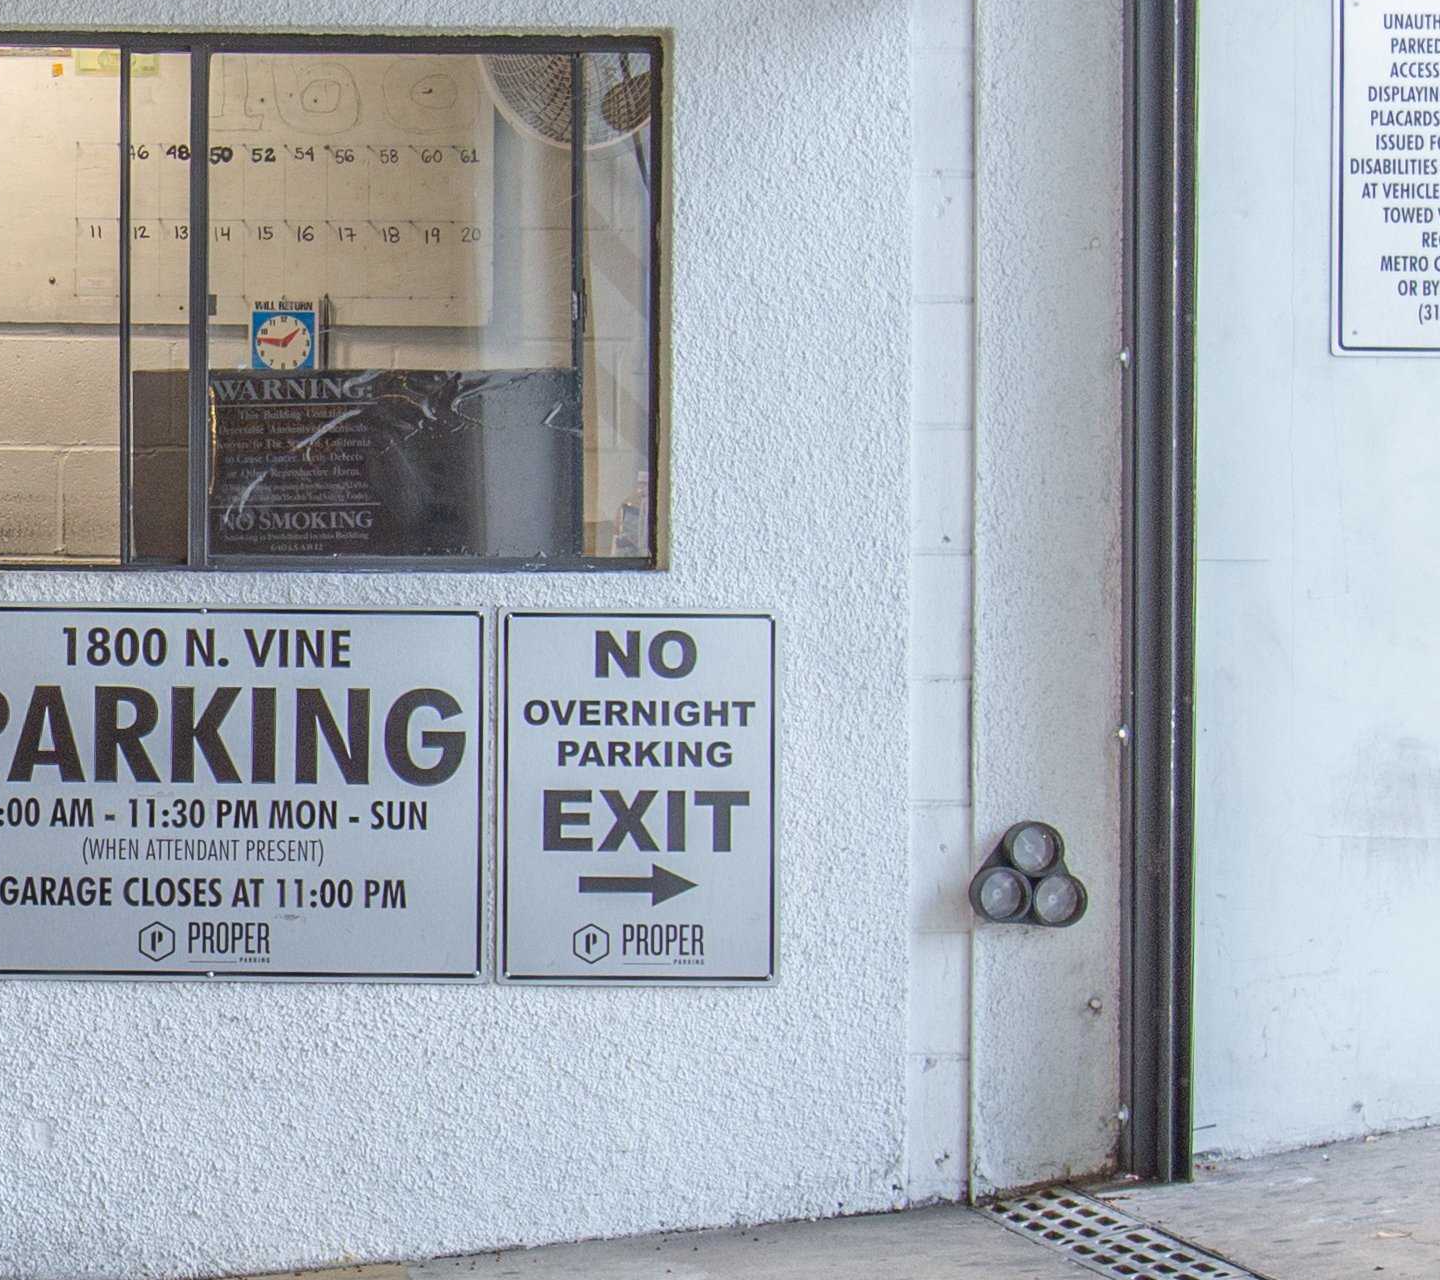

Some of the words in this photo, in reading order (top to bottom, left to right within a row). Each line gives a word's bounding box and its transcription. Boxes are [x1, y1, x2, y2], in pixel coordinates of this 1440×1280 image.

[1371, 110, 1440, 127] PLACARDS
[1376, 134, 1424, 151] ISSUED
[166, 144, 191, 161] 48
[209, 146, 233, 164] 50
[251, 148, 276, 163] 52
[294, 147, 315, 163] 54
[335, 149, 355, 164] 56
[379, 149, 399, 163] 58
[421, 149, 443, 164] 60
[460, 149, 480, 163] 61
[1350, 158, 1438, 175] DISABILITIES
[1362, 183, 1378, 199] AT
[1383, 207, 1434, 224] TOWED
[90, 225, 102, 239] 11
[133, 225, 150, 239] 12
[174, 226, 189, 240] 13
[214, 226, 231, 242] 14
[258, 226, 274, 241] 15
[296, 225, 315, 242] 16
[337, 227, 357, 243] 17
[382, 226, 400, 244] 18
[424, 227, 441, 244] 19
[461, 227, 481, 243] 20
[1380, 255, 1429, 272] METRO
[1398, 280, 1417, 296] OR
[1423, 280, 1440, 296] BY
[254, 300, 275, 311] WILL
[278, 300, 314, 311] RETURN
[212, 377, 373, 402] WARNING:
[258, 510, 375, 530] SMOKING
[63, 627, 167, 667] 1800
[186, 628, 229, 667] N.
[243, 628, 351, 668] VINE
[595, 630, 697, 679] NO
[523, 699, 756, 727] OVERNIGHT
[558, 740, 732, 768] PARKING
[49, 798, 94, 827] AM
[129, 798, 205, 828] 11:30
[216, 799, 258, 829] PM
[269, 800, 337, 830] MON
[371, 801, 427, 830] SUN
[543, 789, 750, 852] EXIT
[82, 836, 139, 865] (WHEN
[145, 838, 240, 861] ATTENDANT
[246, 839, 324, 867] PRESENT)
[0, 876, 112, 906] GARAGE
[123, 877, 222, 907] CLOSES
[231, 878, 264, 908] AT
[277, 879, 353, 908] 11:00
[364, 879, 406, 909] PM
[188, 922, 270, 954] PROPER
[622, 924, 704, 956] PROPER
